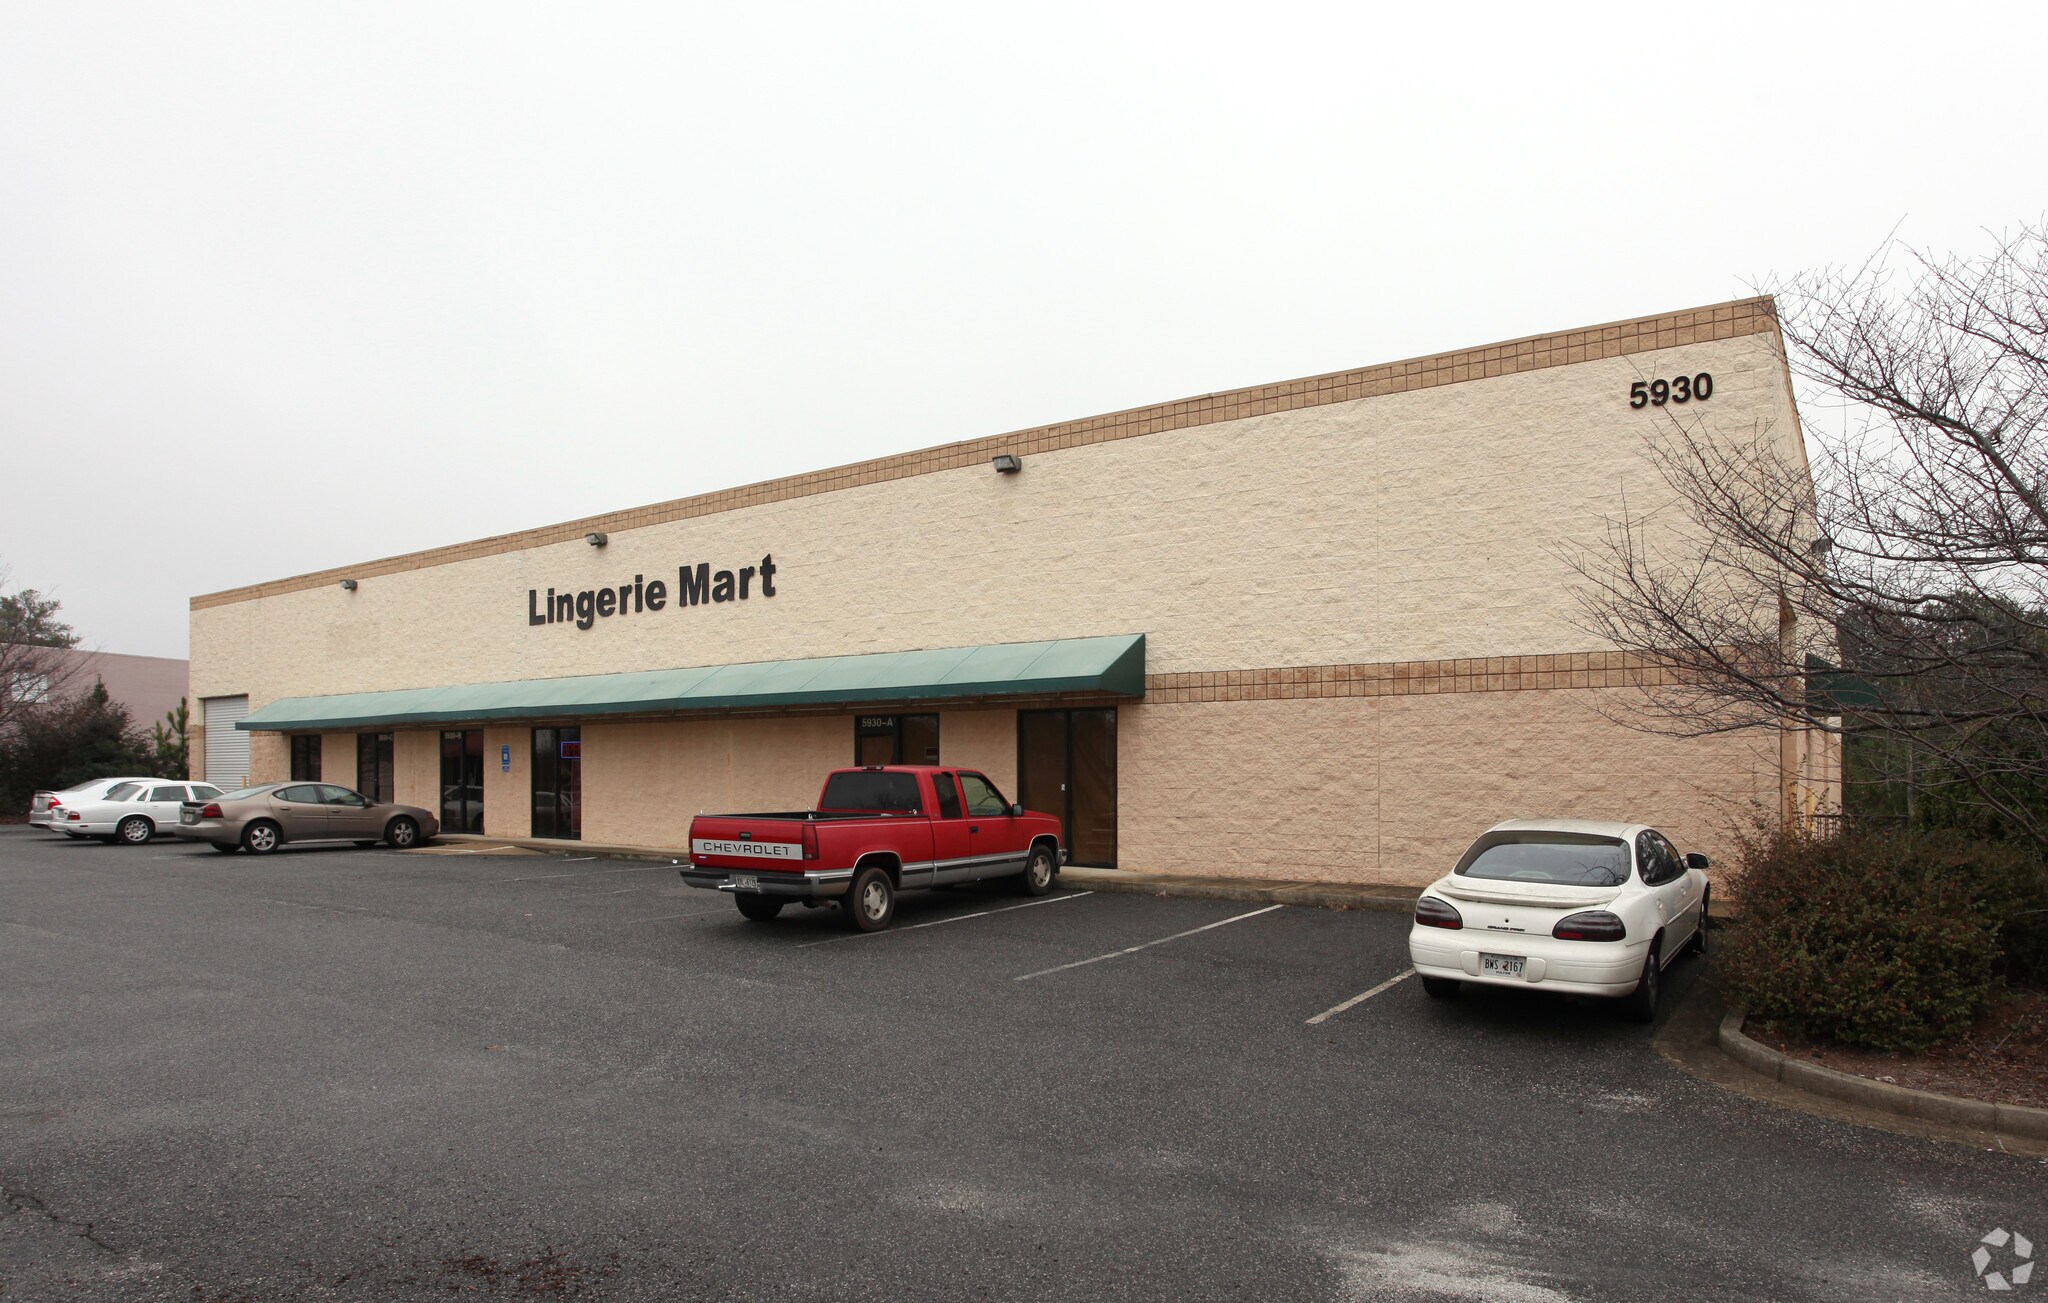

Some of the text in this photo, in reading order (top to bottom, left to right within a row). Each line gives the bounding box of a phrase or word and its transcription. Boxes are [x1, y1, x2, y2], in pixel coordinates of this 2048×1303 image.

[1629, 372, 1713, 410] 5930
[528, 553, 776, 630] Lingerie Mart
[862, 717, 893, 727] 5930-A
[703, 842, 790, 856] CHEVROLET
[1484, 958, 1524, 973] BWS 2167
